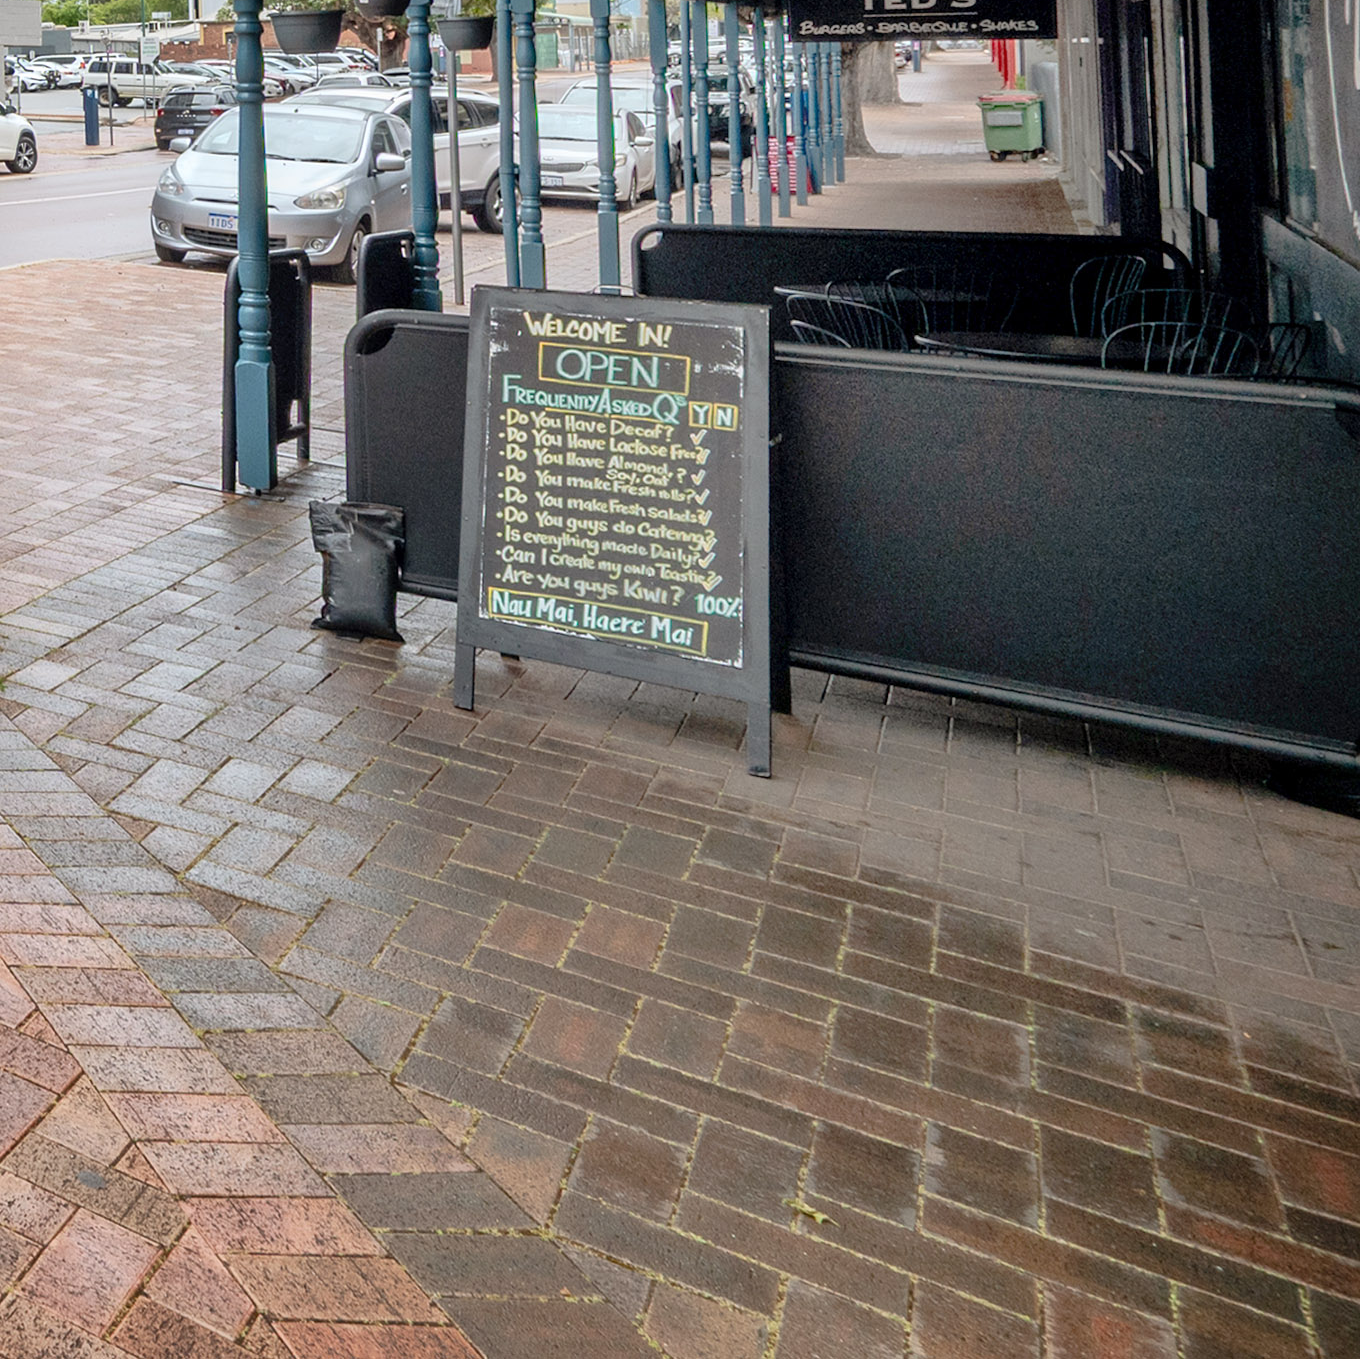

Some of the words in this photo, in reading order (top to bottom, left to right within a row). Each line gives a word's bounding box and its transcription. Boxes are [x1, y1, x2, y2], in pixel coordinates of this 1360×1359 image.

[523, 311, 627, 344] WELCOME
[638, 322, 673, 348] IN!
[556, 349, 659, 388] OPEN
[597, 387, 652, 416] ASKED
[693, 404, 708, 425] Y
[716, 408, 732, 427] N
[506, 408, 529, 426] Do
[530, 411, 562, 429] You
[564, 415, 607, 433] Have
[506, 427, 528, 442] Do
[531, 429, 562, 447] You
[567, 433, 607, 450] Have
[609, 437, 668, 456] Lactose
[506, 443, 527, 461] Do
[533, 448, 563, 466] You
[566, 452, 605, 468] Have
[505, 464, 527, 483] Do
[534, 470, 562, 487] You
[566, 477, 612, 491] make
[613, 481, 656, 497] Fresh
[504, 486, 528, 504] Do
[534, 491, 563, 508] You
[567, 498, 608, 513] make
[608, 499, 646, 517] Fresh
[503, 506, 528, 523] Do
[535, 510, 563, 527] You
[566, 517, 608, 536] guys
[612, 520, 635, 535] do
[505, 524, 521, 542] Is
[523, 531, 600, 556] everything
[601, 540, 648, 556] made
[650, 543, 700, 569] Daily?
[501, 545, 536, 564] Can
[541, 548, 547, 565] I
[549, 554, 595, 570] create
[597, 560, 622, 580] my
[623, 564, 656, 577] own
[502, 563, 534, 585] Are
[574, 580, 619, 600] guys
[492, 590, 532, 617] Nau
[536, 597, 579, 627] Mai,
[650, 615, 694, 646] Mai
[694, 593, 741, 618] 100%
